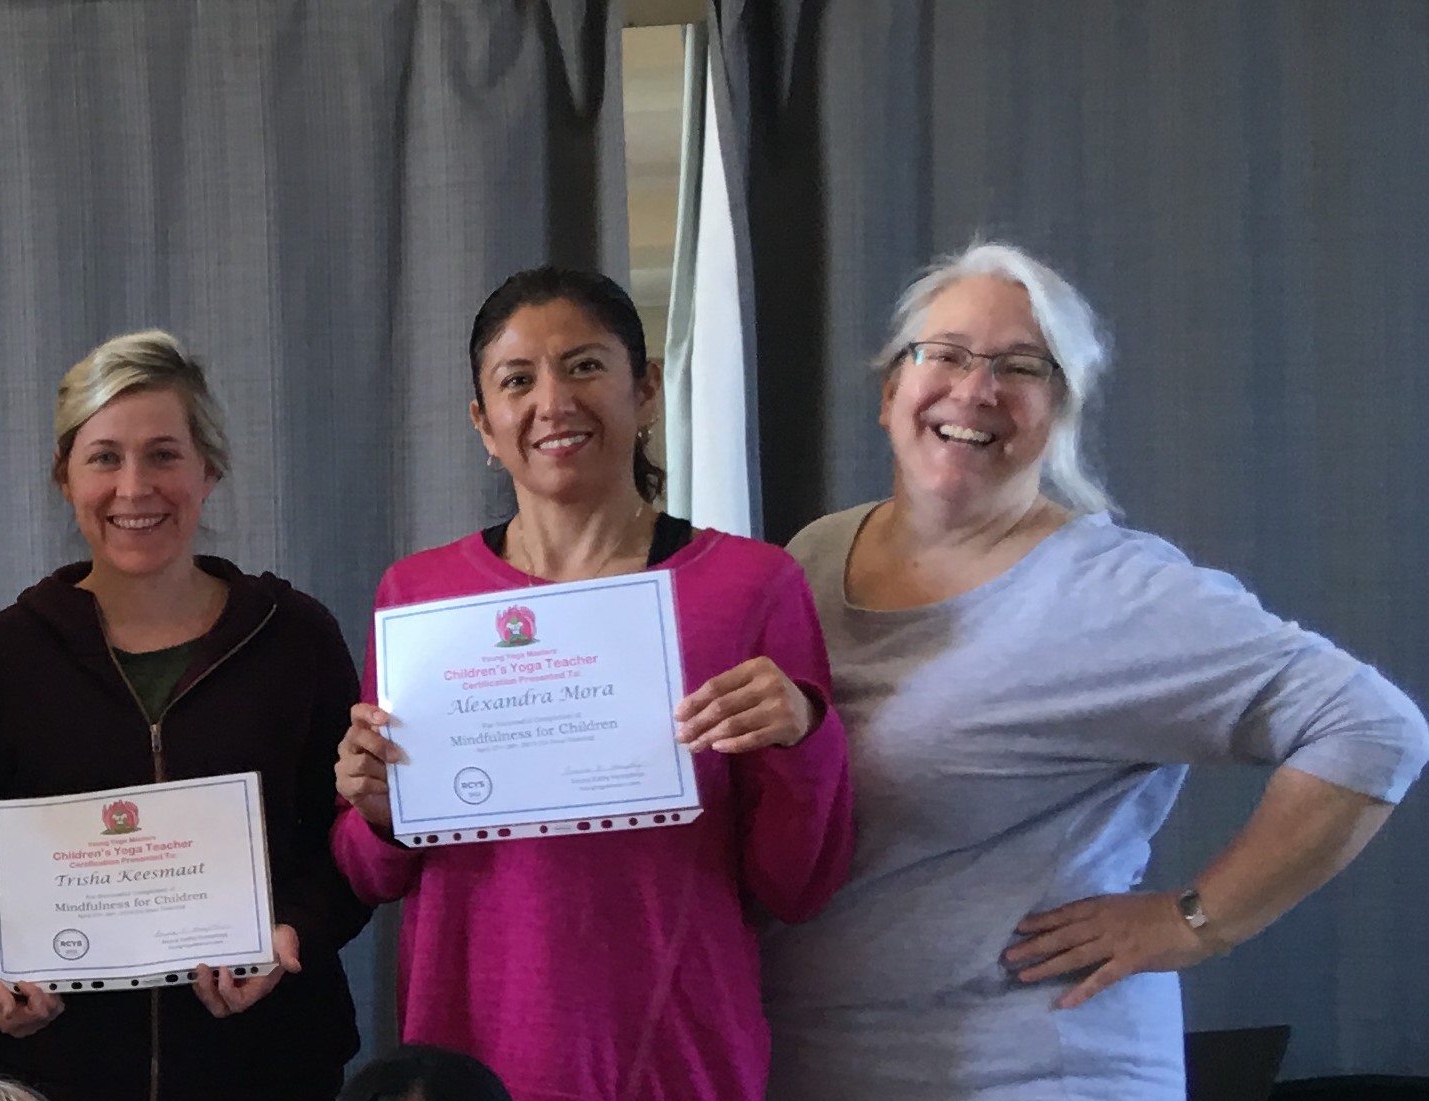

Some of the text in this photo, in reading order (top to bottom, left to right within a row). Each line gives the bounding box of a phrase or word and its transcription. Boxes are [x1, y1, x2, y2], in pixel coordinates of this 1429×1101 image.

[444, 655, 599, 681] Children's Yoga Teacher
[462, 678, 517, 691] Certification
[518, 671, 566, 683] Presented
[447, 684, 614, 715] Alexandra Mora
[450, 730, 532, 747] Mindfulness
[536, 726, 555, 737] for
[558, 720, 618, 735] Children
[52, 840, 193, 861] Children's Yoga Teacher
[69, 859, 120, 869] Certification
[121, 853, 163, 864] Presented
[55, 863, 205, 887] Trisha Keesmaat
[55, 901, 130, 912] Mindfulness
[134, 897, 151, 907] for
[154, 892, 208, 905] Children
